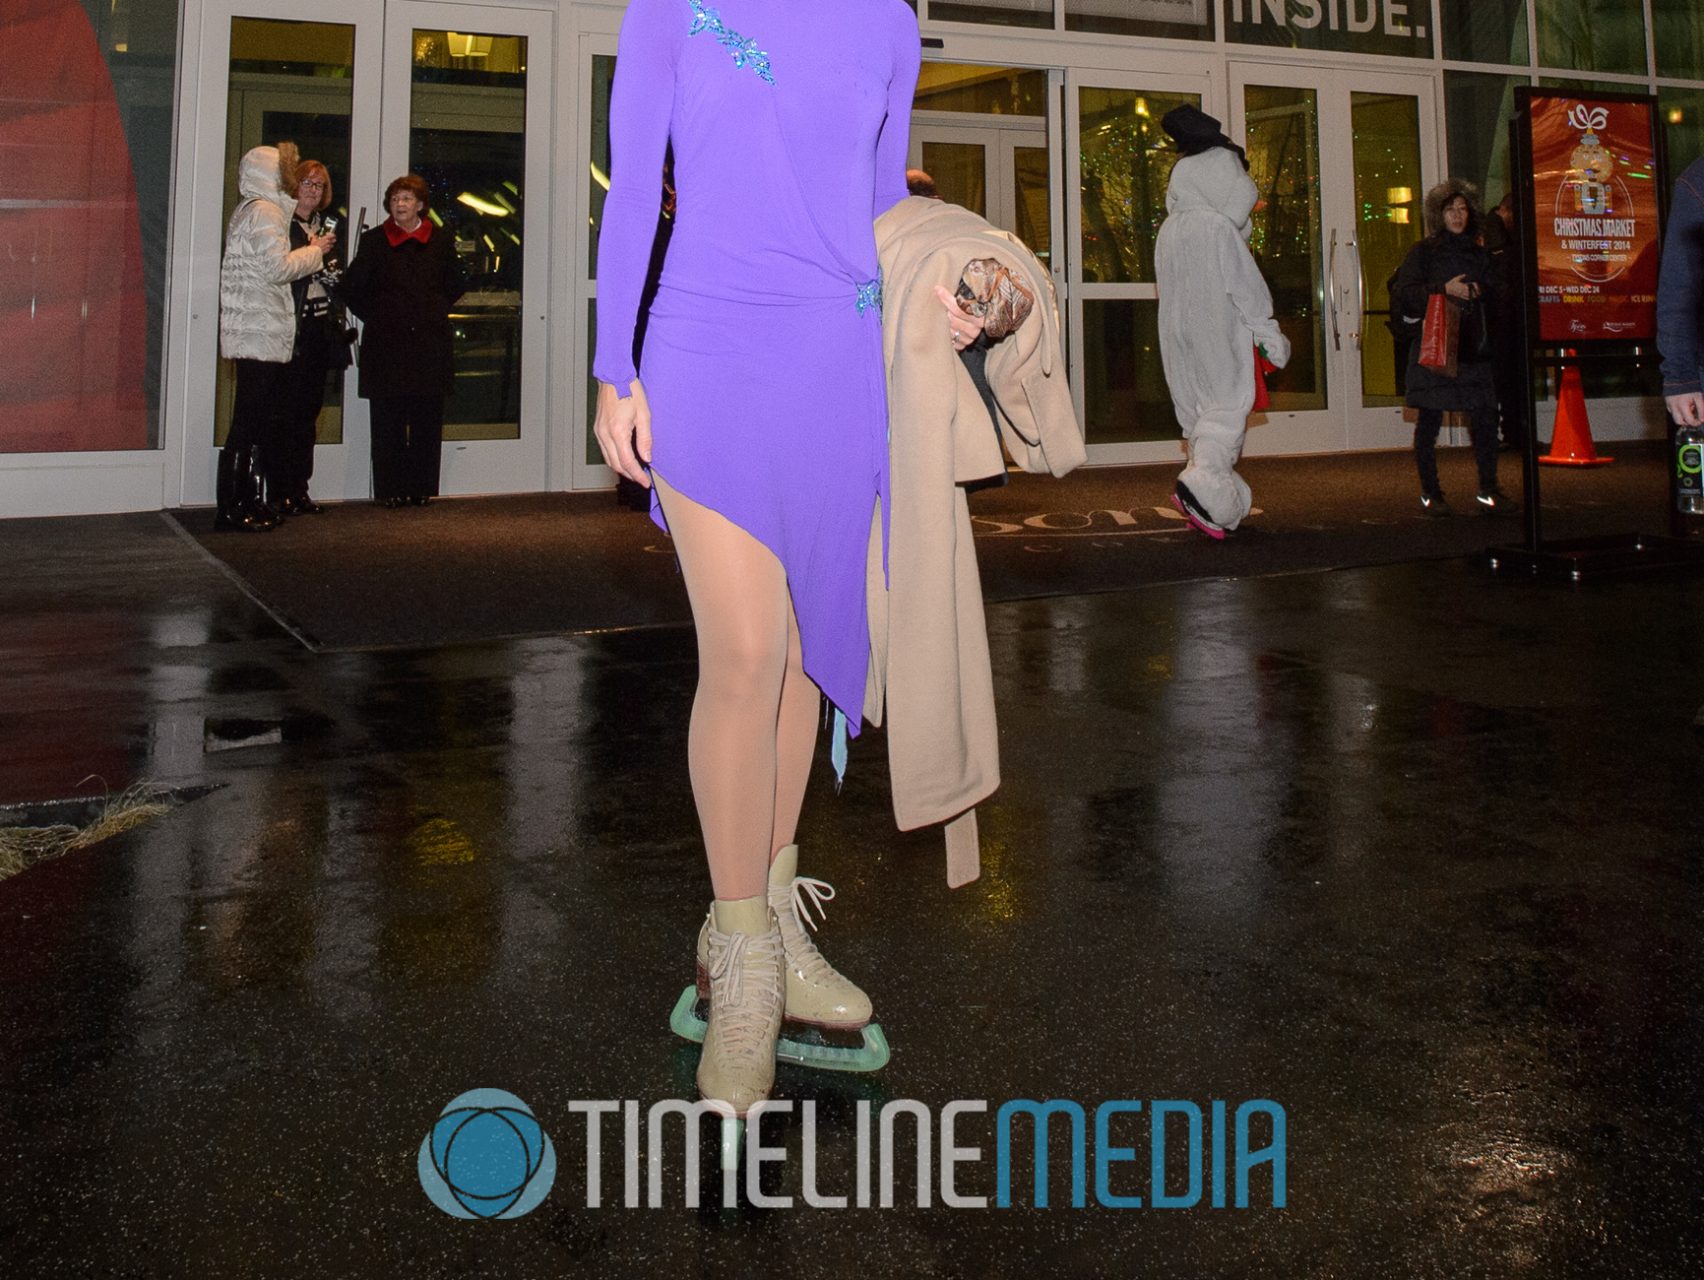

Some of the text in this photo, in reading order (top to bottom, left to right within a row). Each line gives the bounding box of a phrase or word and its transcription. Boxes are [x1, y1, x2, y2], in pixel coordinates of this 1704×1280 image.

[1554, 218, 1635, 237] CHRISTMAS MARKET
[1561, 240, 1631, 250] & WINTERFEST 2014
[1563, 295, 1584, 303] DRINK
